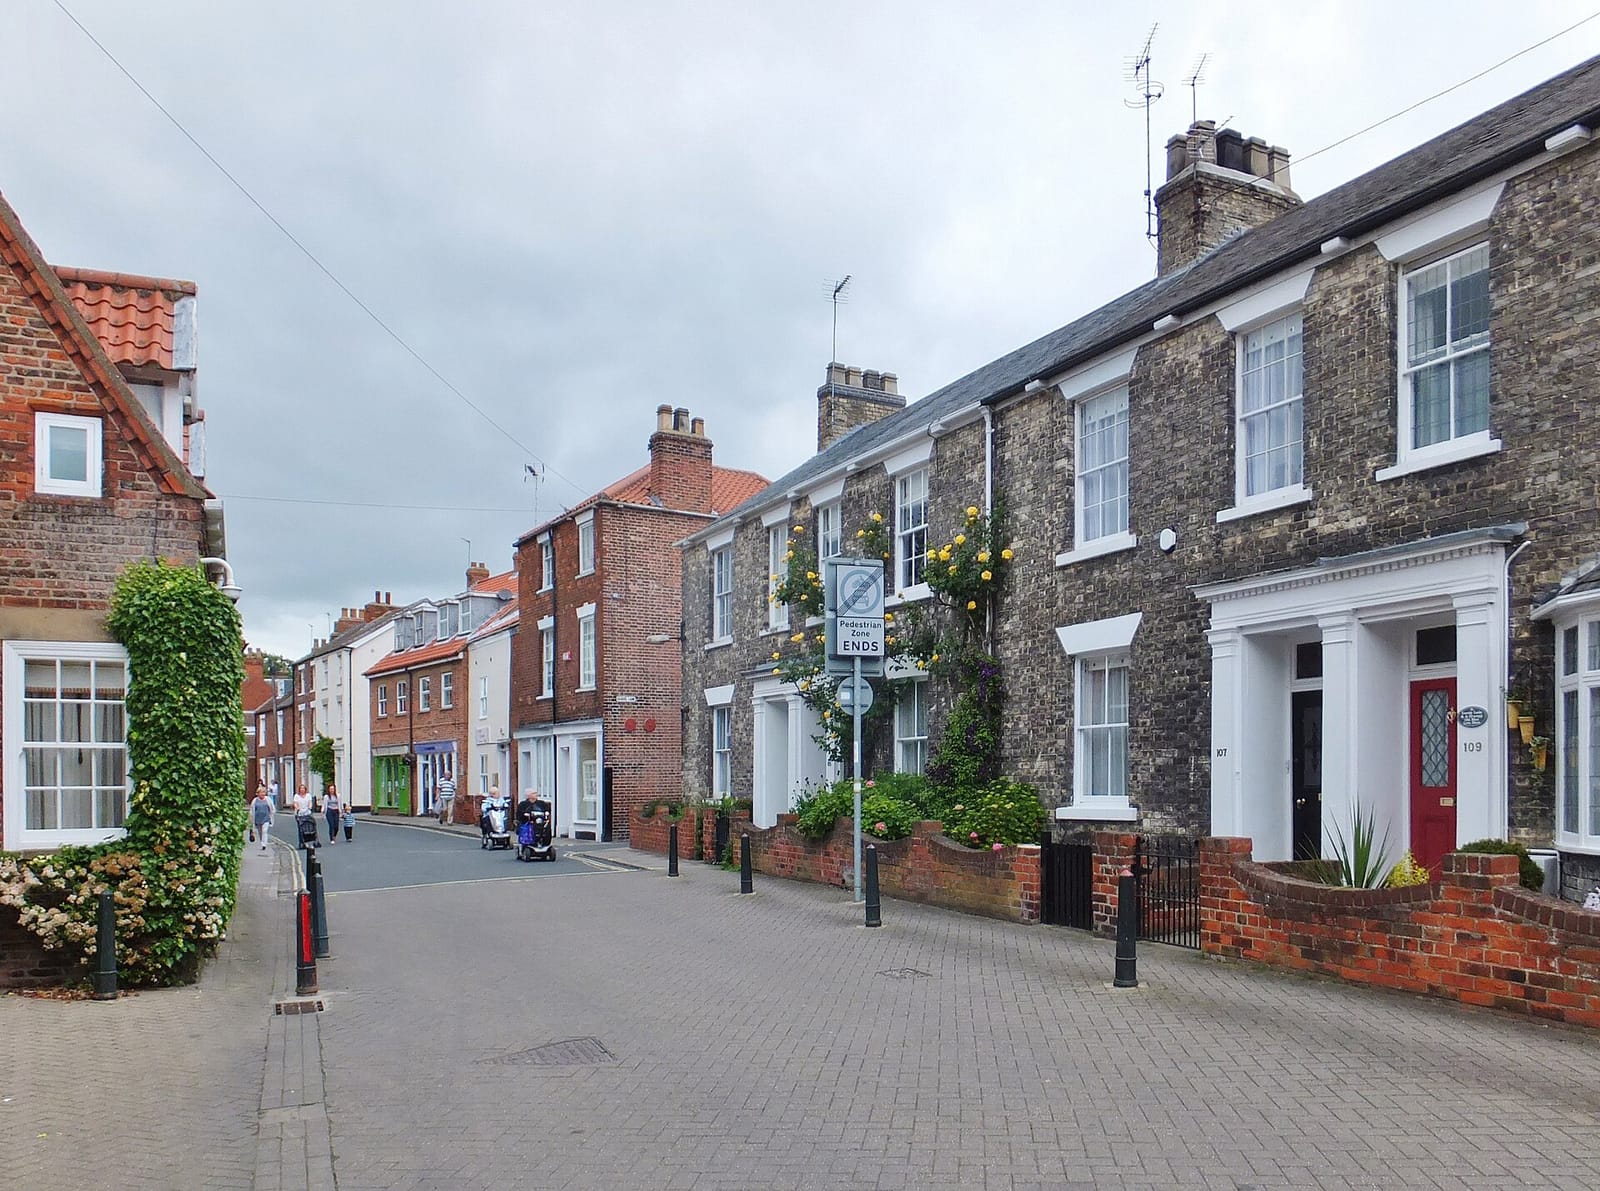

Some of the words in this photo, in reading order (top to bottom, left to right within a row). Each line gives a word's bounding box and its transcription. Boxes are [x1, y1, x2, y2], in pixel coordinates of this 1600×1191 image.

[840, 620, 882, 629] Pedestrian
[851, 629, 871, 637] Zone
[843, 640, 879, 652] ENDS
[1463, 742, 1482, 753] 109
[1216, 748, 1228, 758] 107
